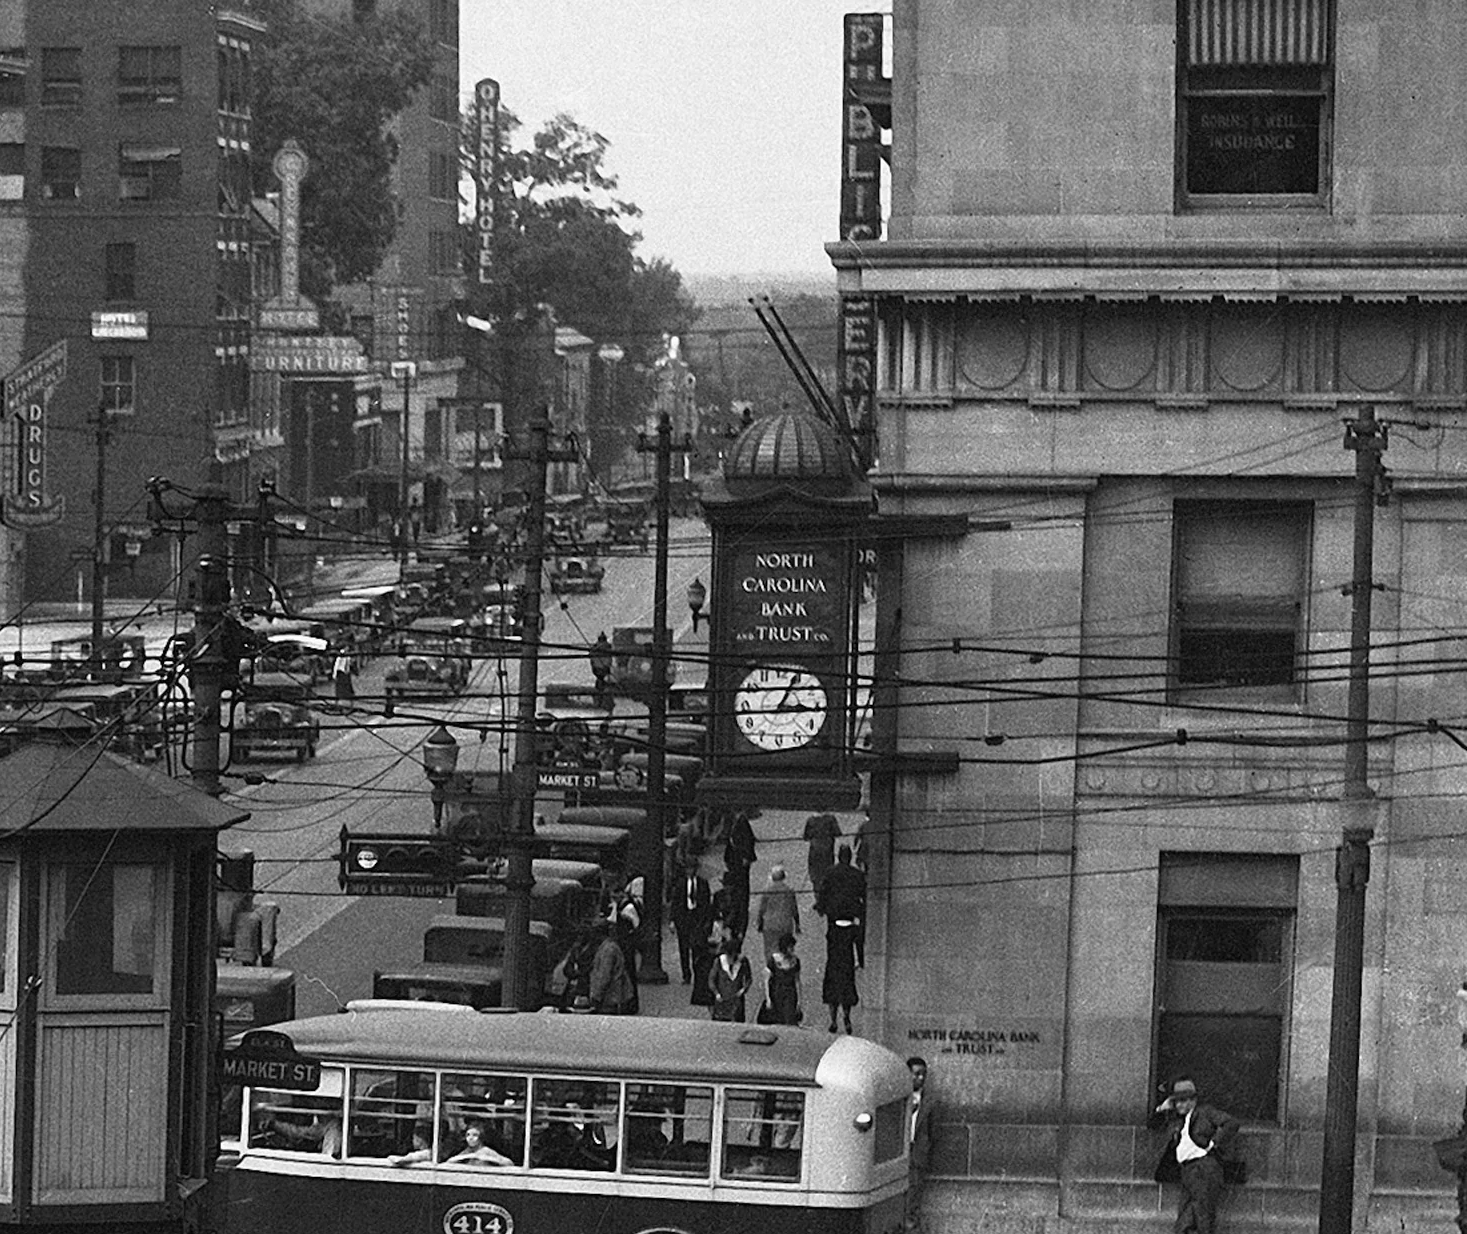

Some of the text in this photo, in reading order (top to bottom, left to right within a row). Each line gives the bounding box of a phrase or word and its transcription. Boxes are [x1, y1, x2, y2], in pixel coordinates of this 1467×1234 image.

[479, 198, 494, 284] HOTEL
[28, 404, 42, 507] DRUGS
[755, 554, 814, 568] NORTH
[742, 577, 827, 592] CAROLINA
[761, 602, 807, 617] BANK
[755, 625, 813, 641] TRUST
[539, 774, 580, 788] MARKET
[908, 1028, 1041, 1044] NORTH CAROLINA BANK
[956, 1043, 993, 1055] TRUST
[223, 1058, 288, 1080] MARKET
[453, 1215, 502, 1234] 414
